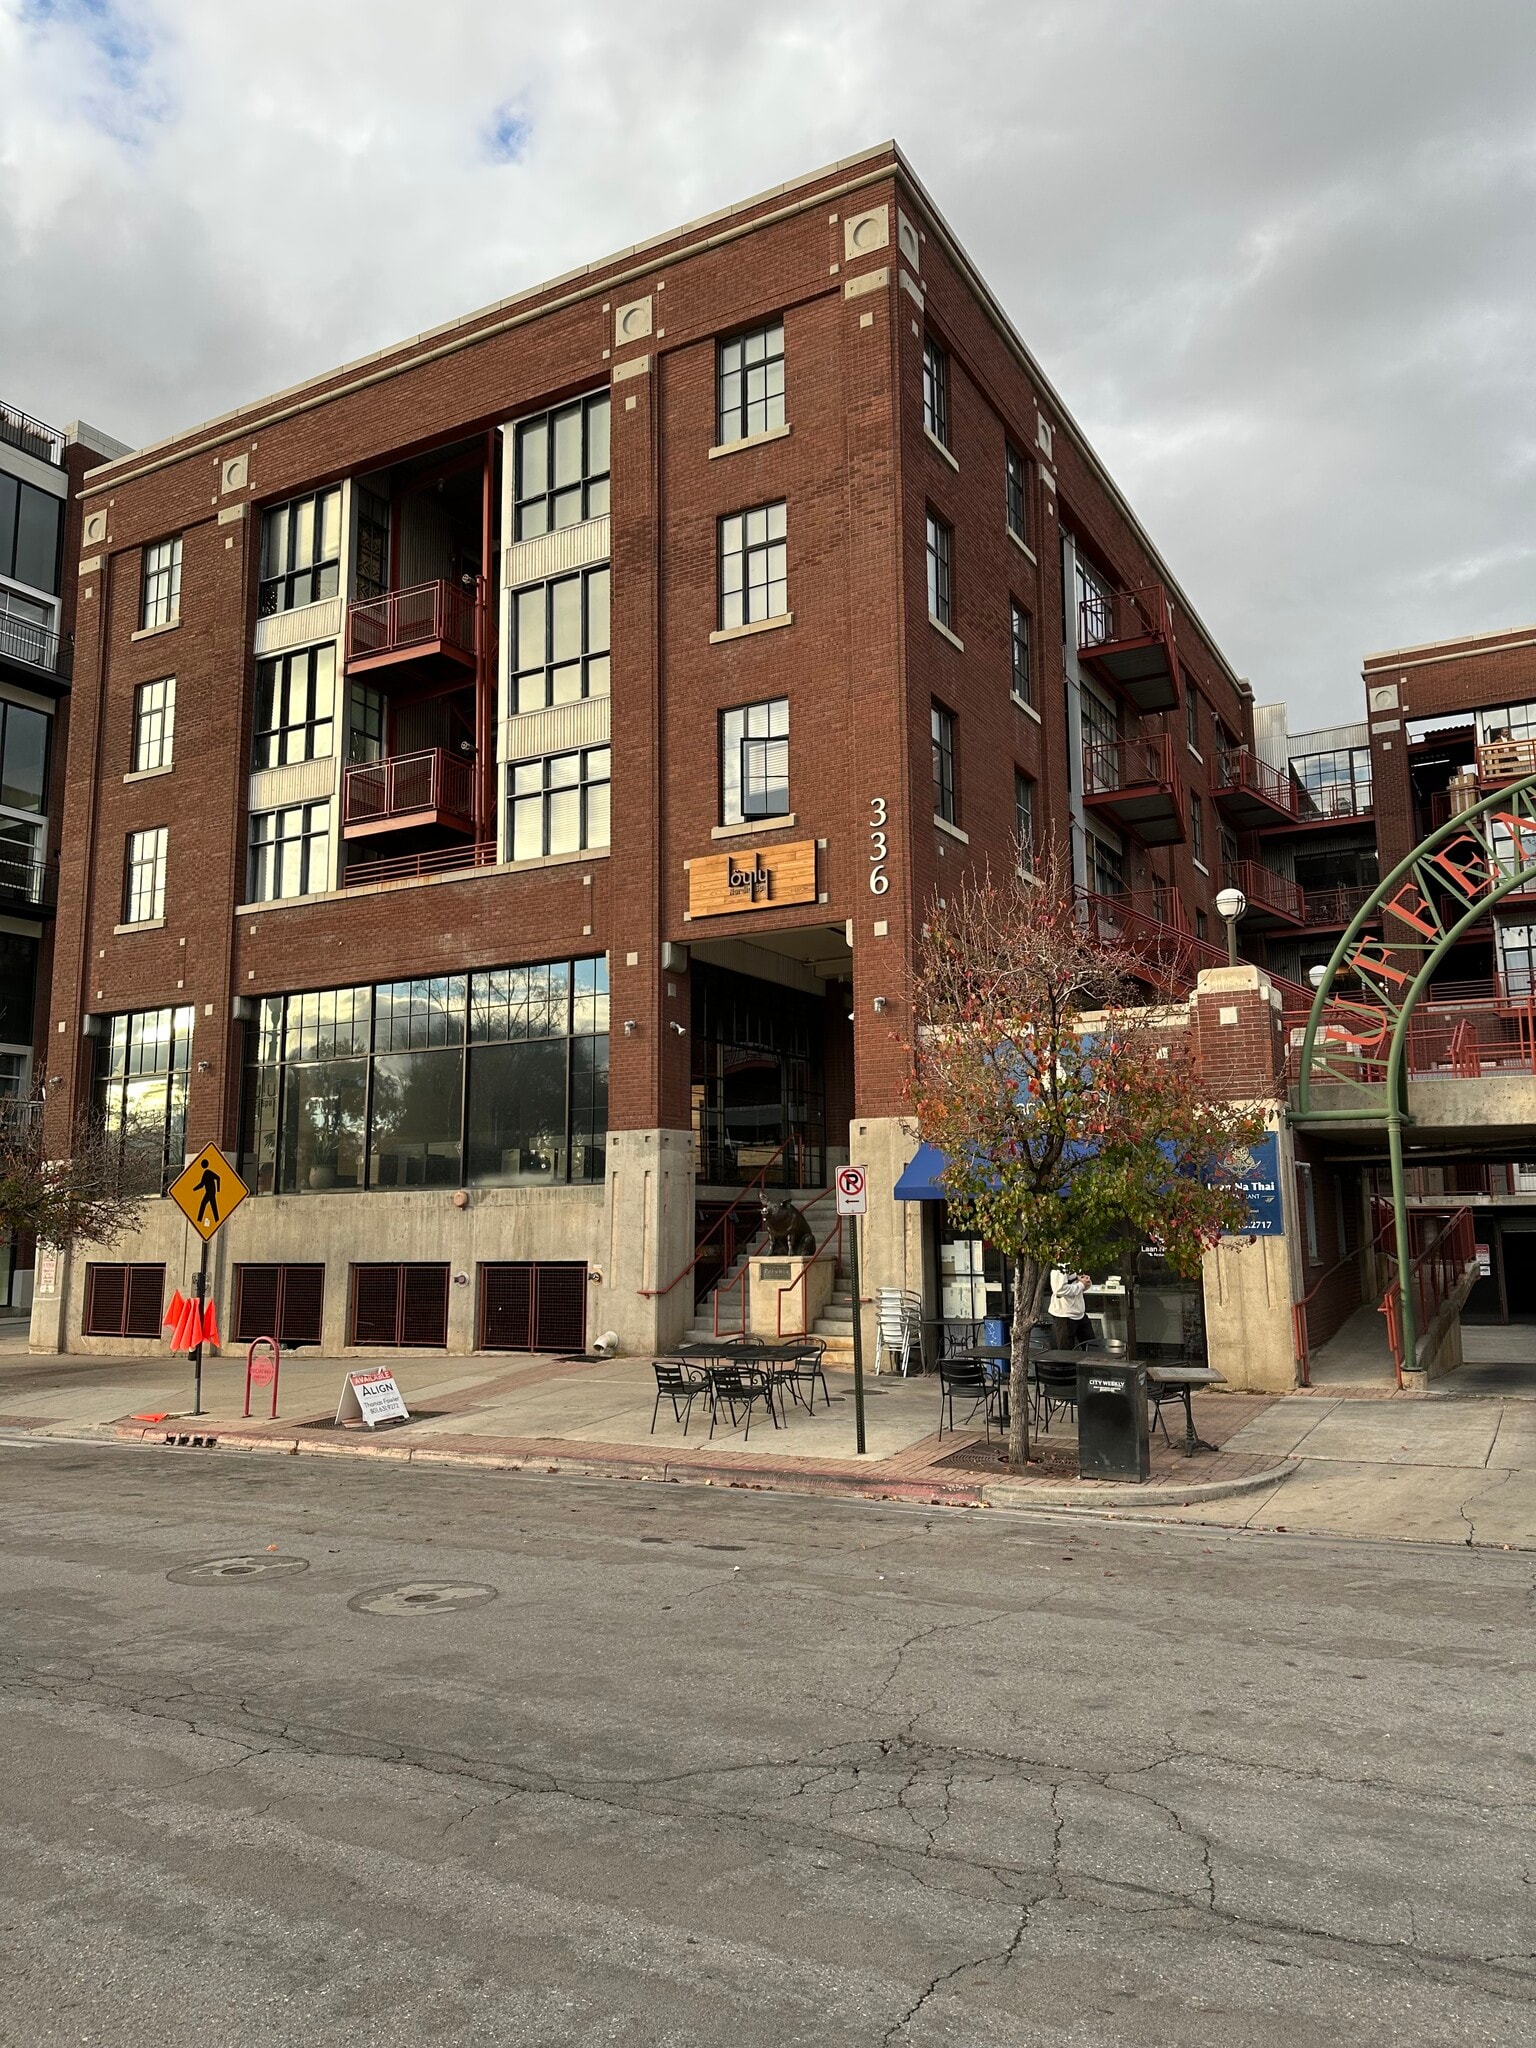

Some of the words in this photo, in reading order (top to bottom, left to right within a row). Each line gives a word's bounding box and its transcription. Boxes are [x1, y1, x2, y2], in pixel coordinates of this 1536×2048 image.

[870, 797, 889, 895] 336
[1251, 1181, 1275, 1191] Thai
[362, 1383, 394, 1397] ALIGN
